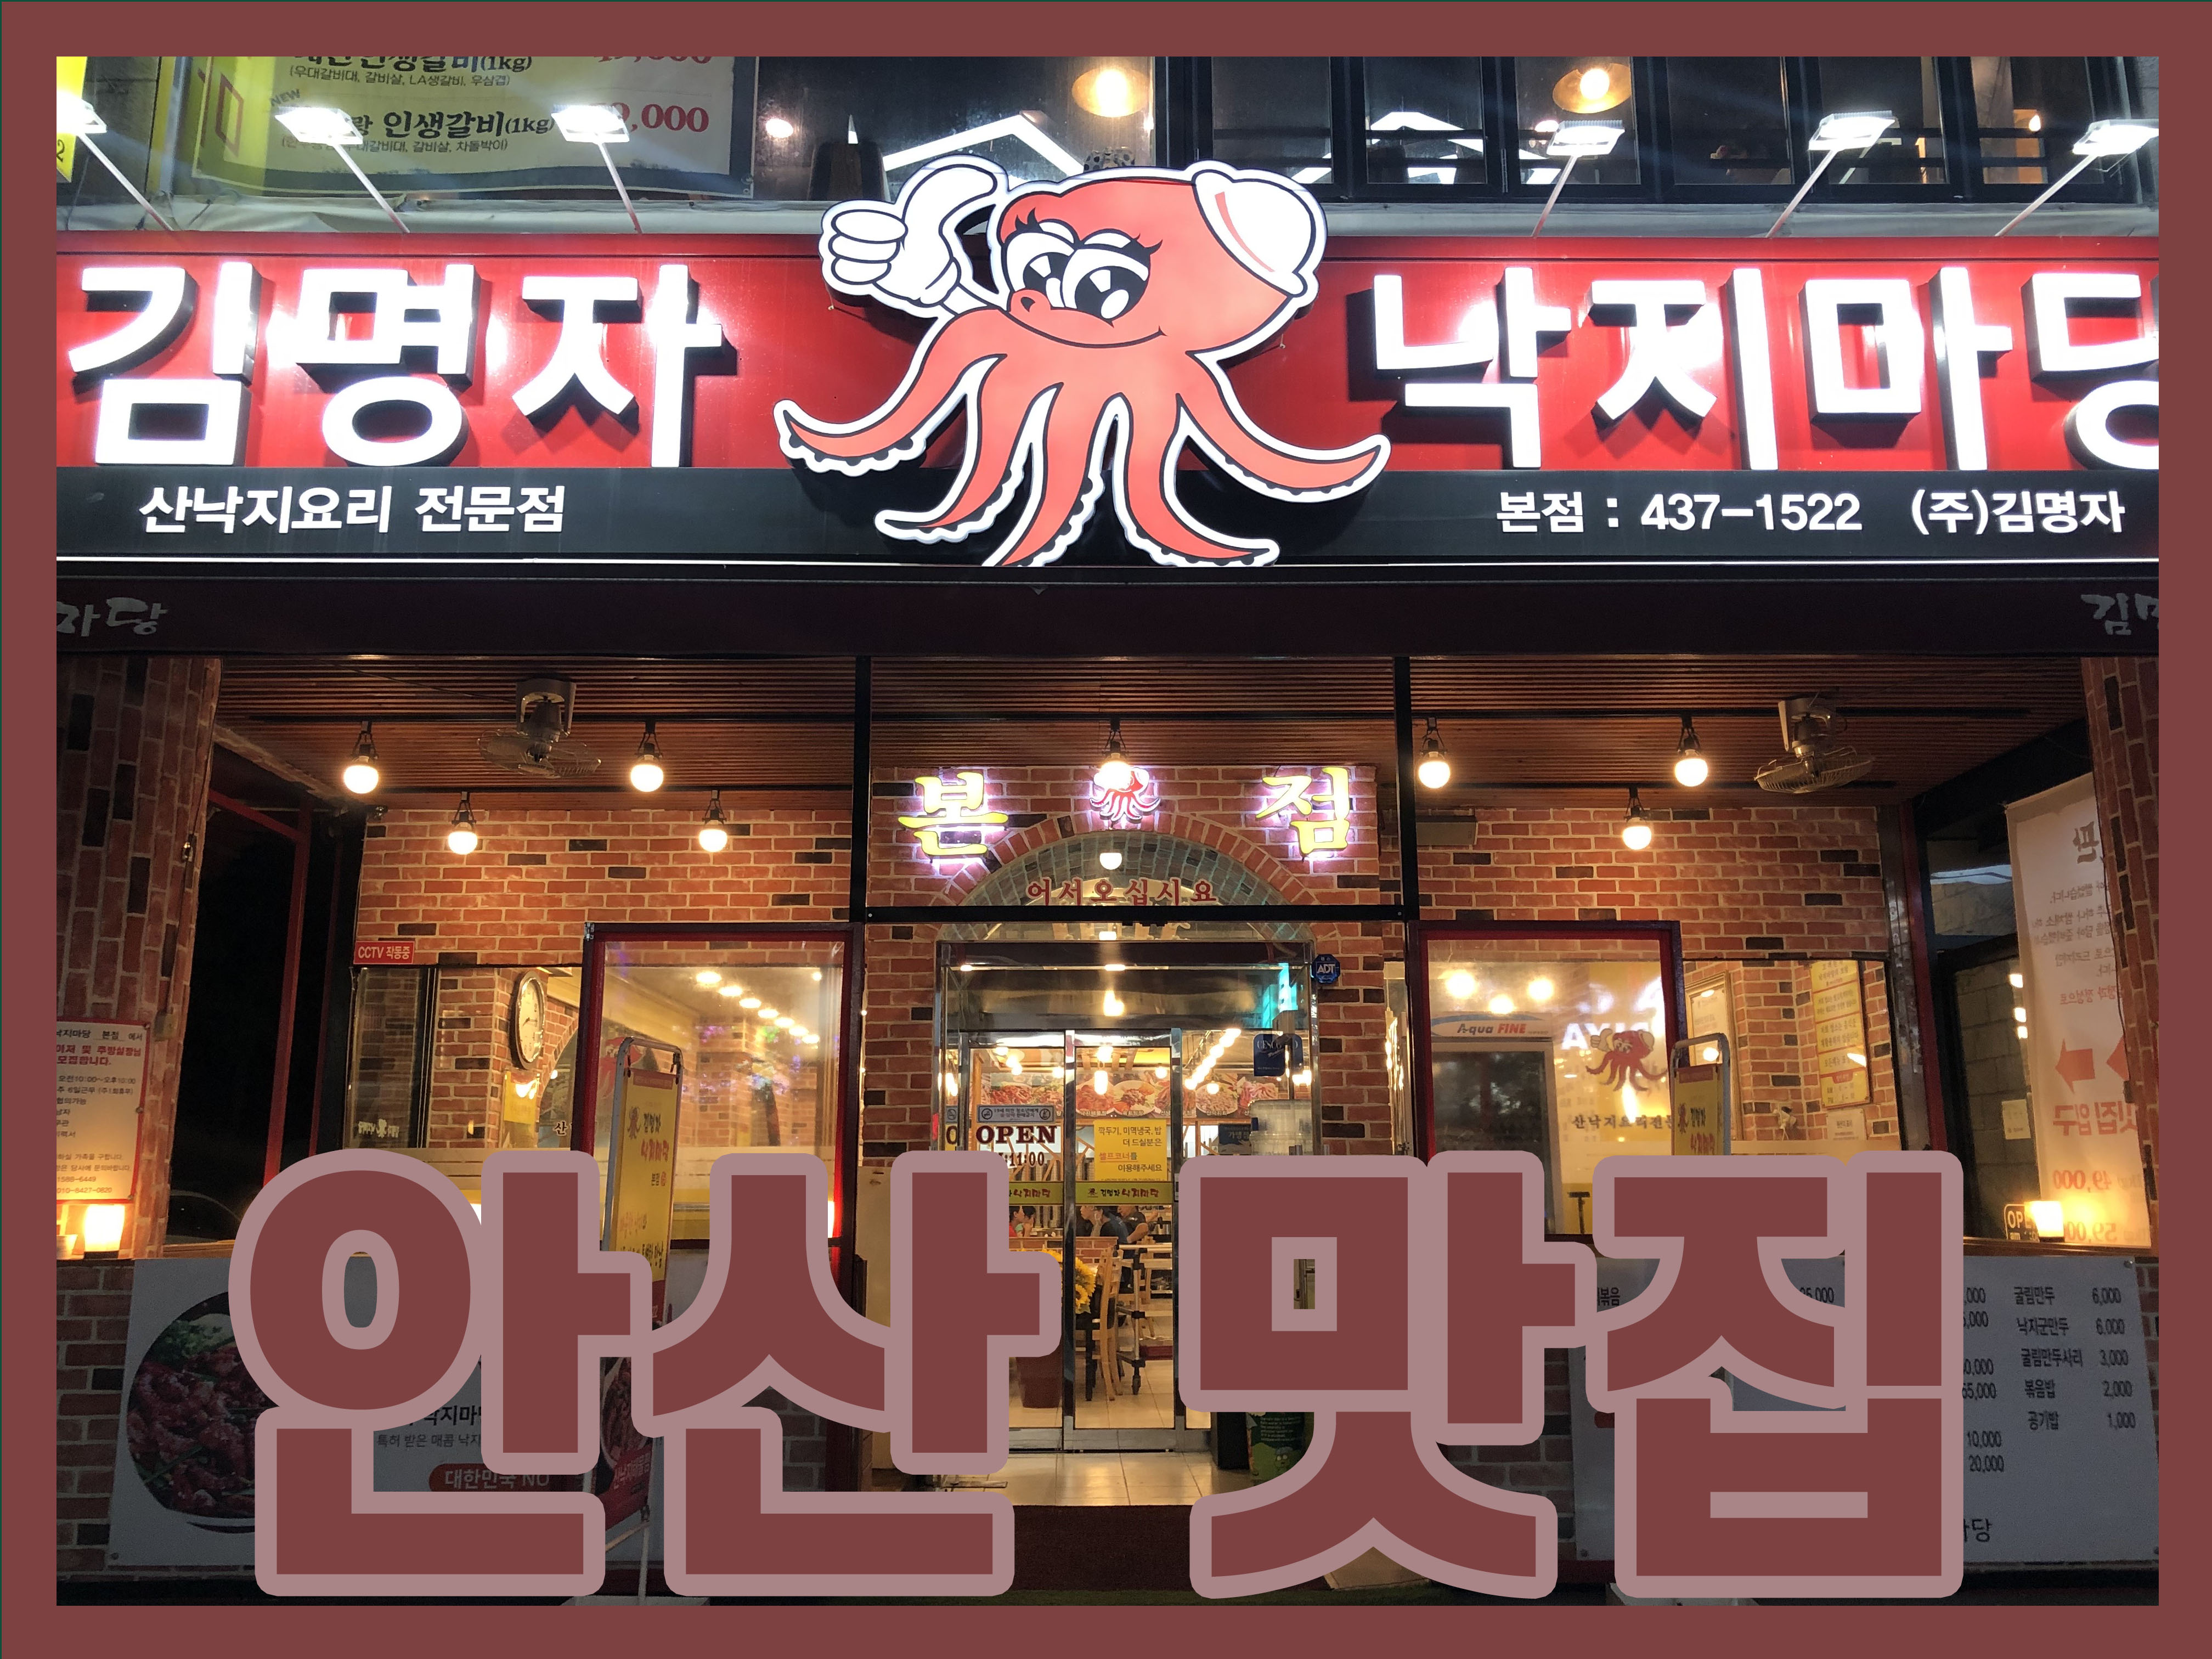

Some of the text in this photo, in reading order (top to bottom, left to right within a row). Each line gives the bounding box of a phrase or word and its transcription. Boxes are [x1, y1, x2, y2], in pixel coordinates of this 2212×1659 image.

[365, 71, 405, 85] 갈비살,
[470, 75, 510, 87] 우삼겹)
[269, 89, 301, 105] NEW
[383, 110, 554, 138] 인생갈비(1kg)
[608, 103, 709, 133] 9,000
[413, 141, 453, 154] 갈비살,
[456, 140, 508, 153] 차돌박이)
[69, 261, 724, 467] 김명자
[139, 485, 566, 533] 산낙지요리 전문점
[1496, 490, 2125, 534] 본점 : 437-1522 (주)김명자
[898, 771, 1008, 856] 본
[1256, 766, 1351, 855] 점
[1025, 876, 1218, 906] 어서오십시요
[358, 945, 410, 960] CCTV 작동중
[1317, 964, 1336, 974] ADT
[1457, 1023, 1494, 1035] Aqua
[1497, 1023, 1527, 1034] FINE
[554, 1121, 567, 1136] 산
[975, 1126, 1057, 1144] OPEN
[1154, 1126, 1162, 1135] 밥
[1122, 1138, 1131, 1147] 더
[1118, 1164, 1163, 1173] 이용해주세요
[1100, 1188, 1120, 1197] 김명자
[2014, 1286, 2055, 1305] 굴림만두
[2092, 1287, 2122, 1305] 6,000
[2016, 1317, 2069, 1335] 낙지군만두
[2096, 1317, 2125, 1335] 6,000
[2021, 1348, 2084, 1367] 굴림만두사리
[2099, 1348, 2129, 1367] 3,000
[2024, 1379, 2056, 1399] 볶음밥
[2102, 1380, 2134, 1399] 2,000
[2027, 1410, 2137, 1431] 공기밥 1,000
[377, 1434, 400, 1448] 특허
[404, 1434, 427, 1448] 받은
[431, 1434, 454, 1448] 매콤
[1967, 1430, 2002, 1448] 10,000
[1968, 1454, 2004, 1473] 20,000
